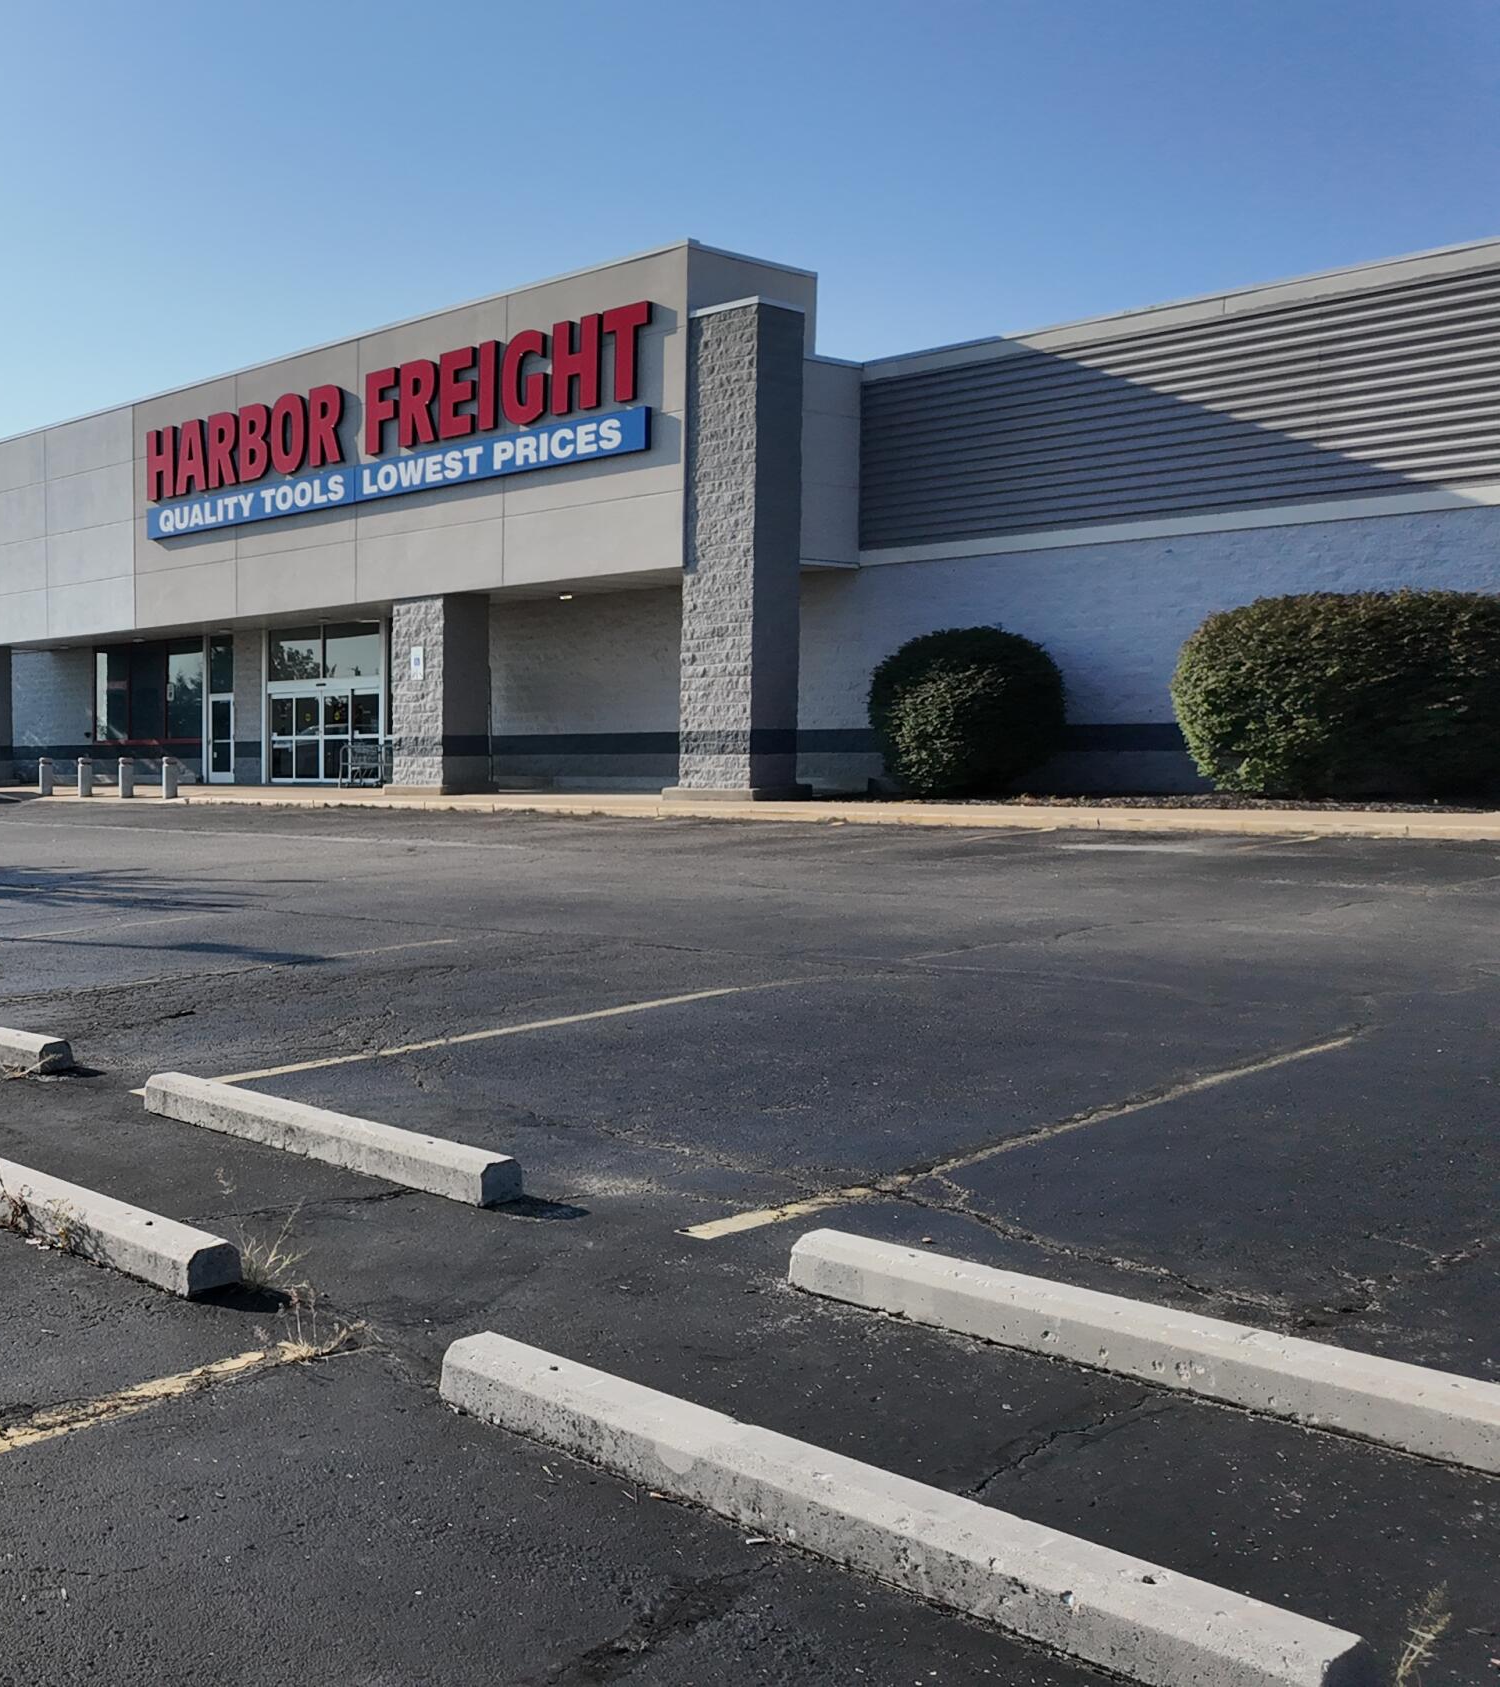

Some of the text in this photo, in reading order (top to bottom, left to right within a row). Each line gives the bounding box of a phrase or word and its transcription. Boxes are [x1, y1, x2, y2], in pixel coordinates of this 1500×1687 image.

[146, 301, 652, 501] HARBOR FREIGHT
[159, 418, 622, 534] QUALITY TOOLS LOWEST PRICES
